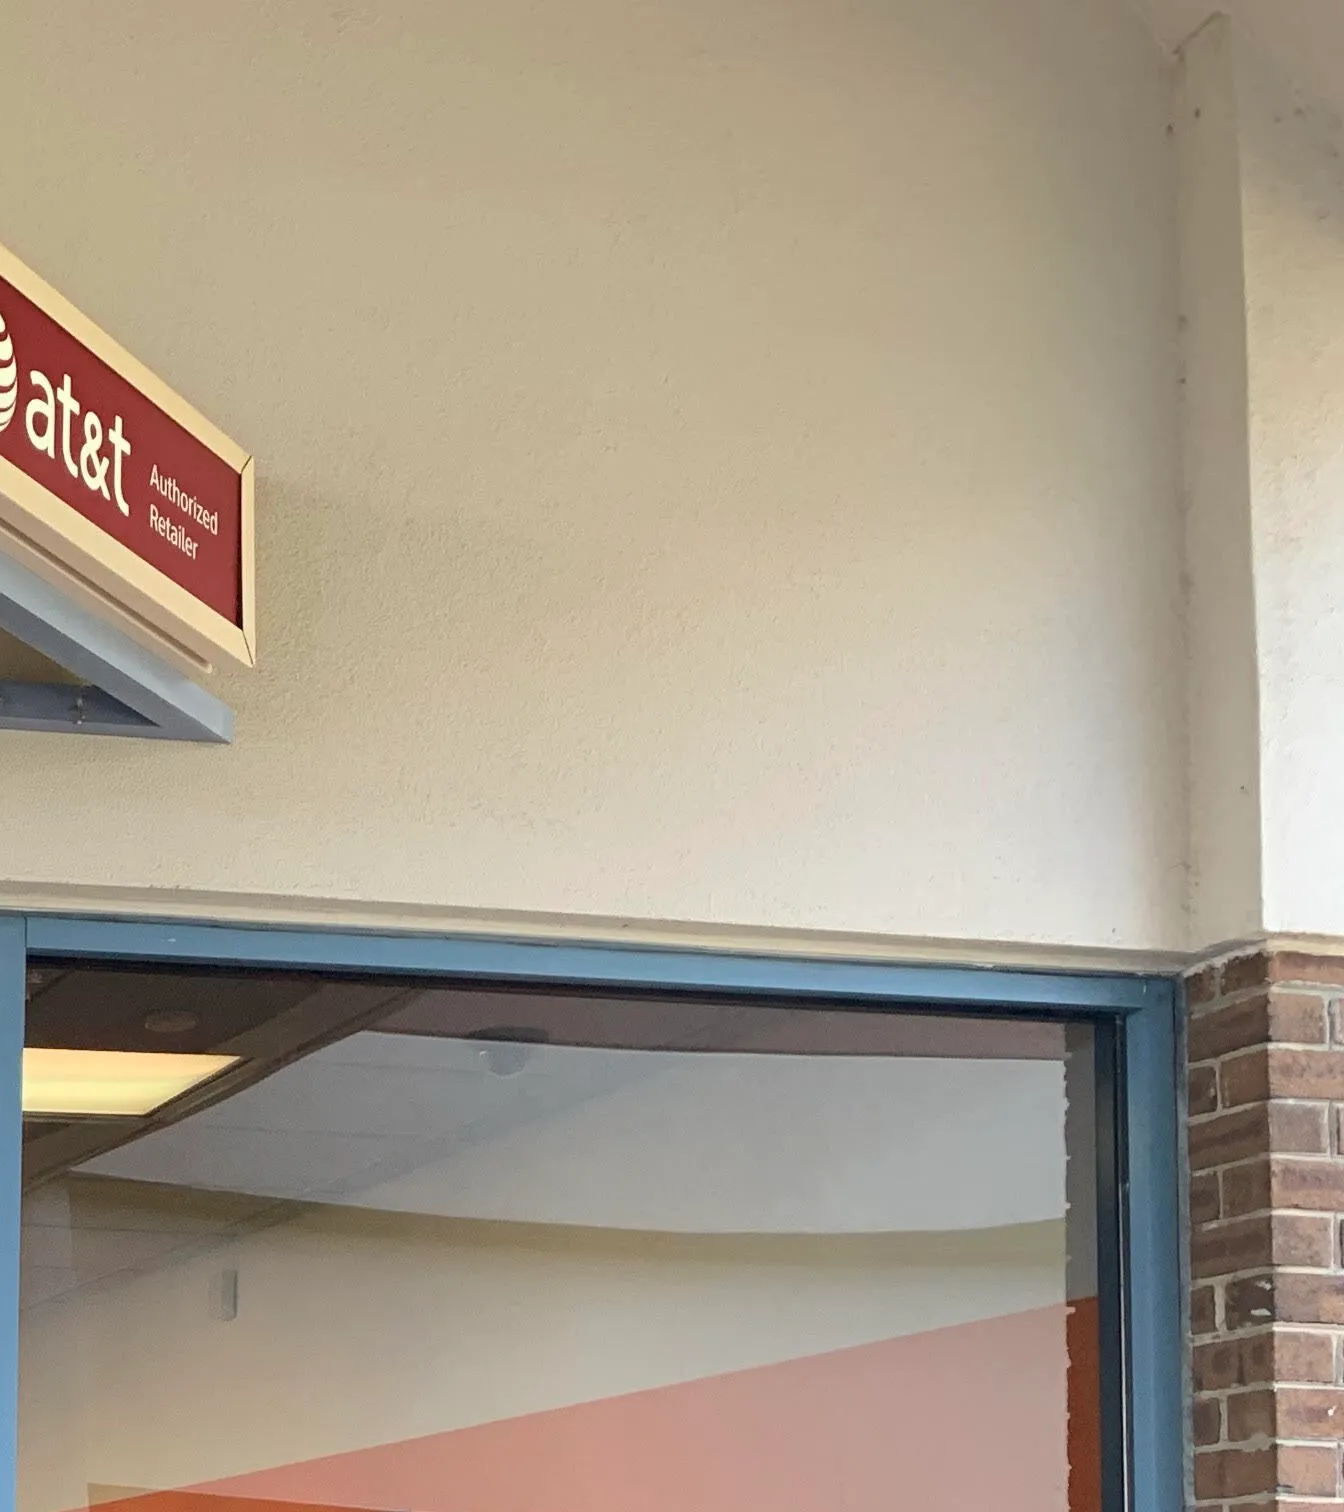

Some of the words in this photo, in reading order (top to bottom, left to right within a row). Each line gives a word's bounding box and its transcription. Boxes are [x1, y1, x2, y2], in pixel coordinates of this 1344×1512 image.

[25, 370, 131, 517] at&t
[149, 504, 200, 561] Retailer
[150, 464, 218, 536] Authorized
